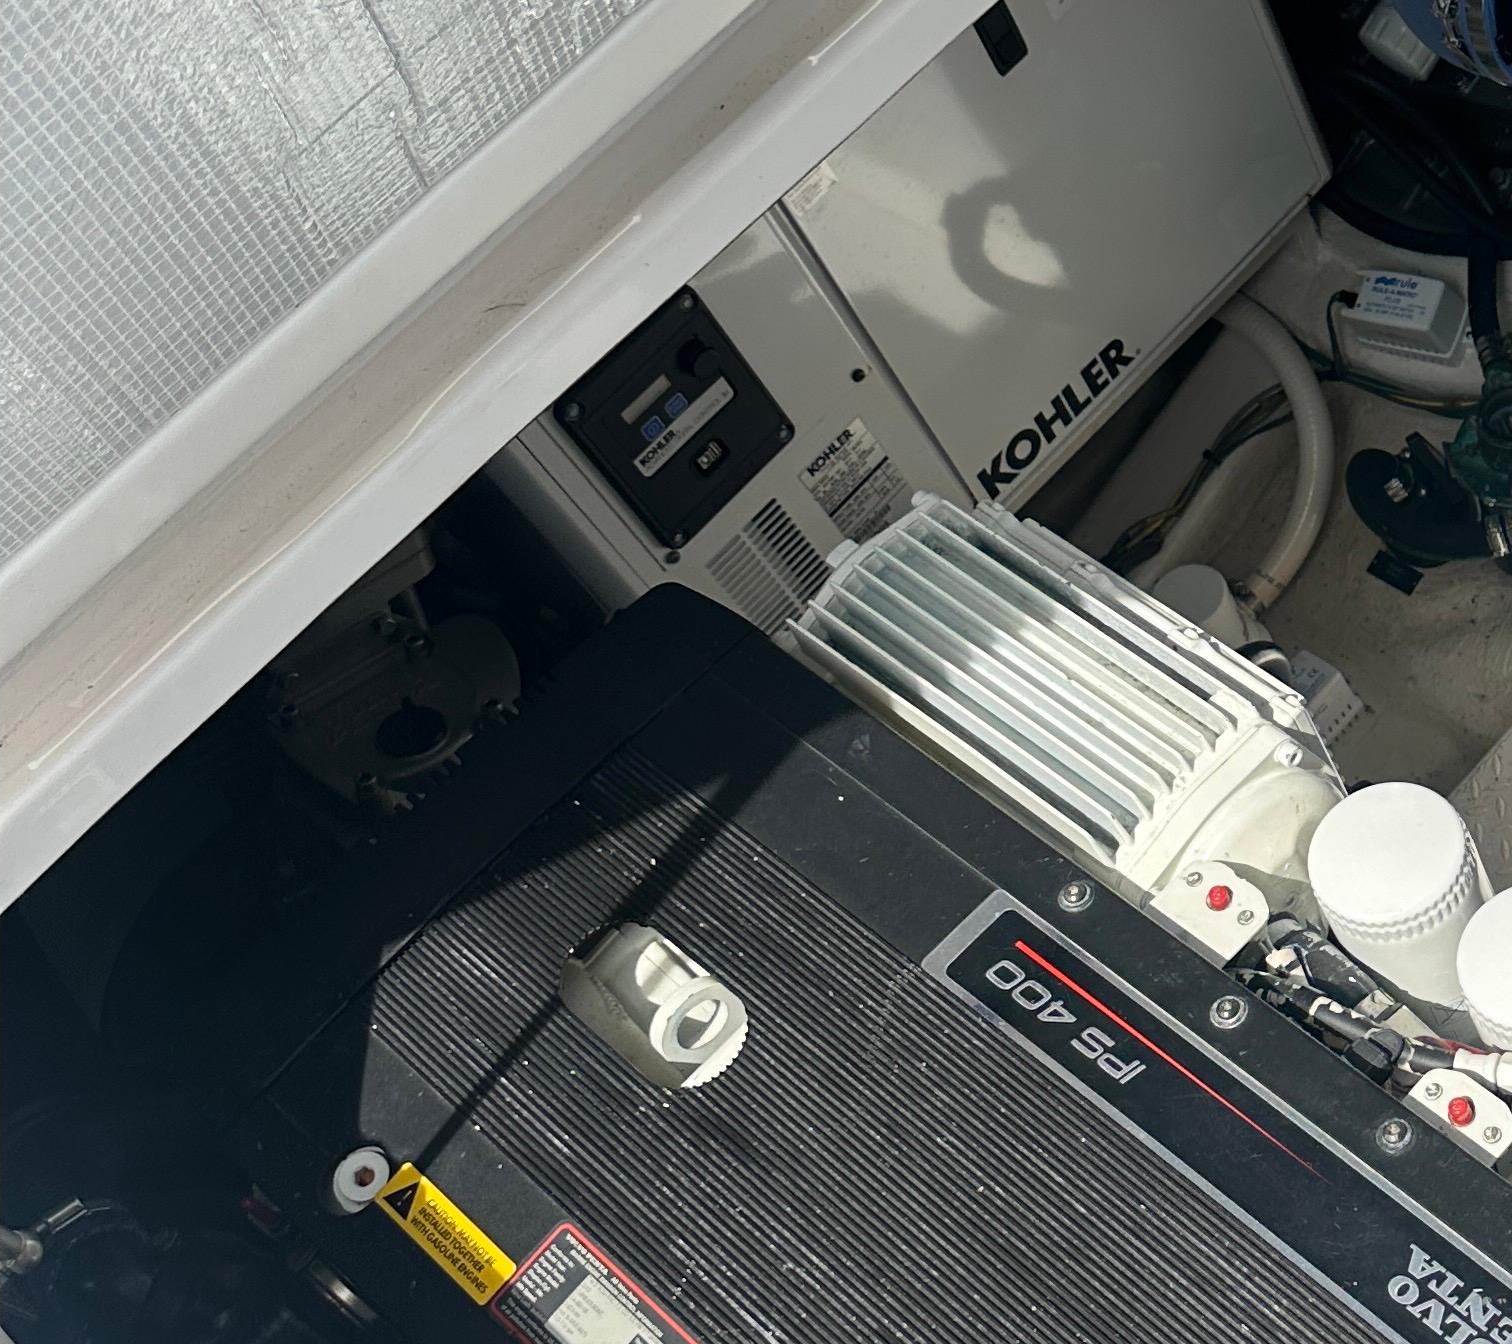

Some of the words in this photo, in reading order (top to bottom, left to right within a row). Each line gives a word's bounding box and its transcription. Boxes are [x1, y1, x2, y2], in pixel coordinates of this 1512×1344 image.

[976, 336, 1136, 500] KOHLER
[640, 430, 676, 467] KOHLER
[806, 429, 853, 476] KOHLER
[985, 960, 1077, 1023] 400
[1070, 1026, 1147, 1084] IPS
[409, 1215, 429, 1236] WITH
[425, 1232, 460, 1267] GASOLINE
[456, 1262, 488, 1294] ENGINES
[417, 1206, 452, 1241] INSTALLED
[448, 1236, 484, 1273] TOGETHER
[456, 1229, 473, 1245] MAY
[469, 1241, 488, 1259] NOT
